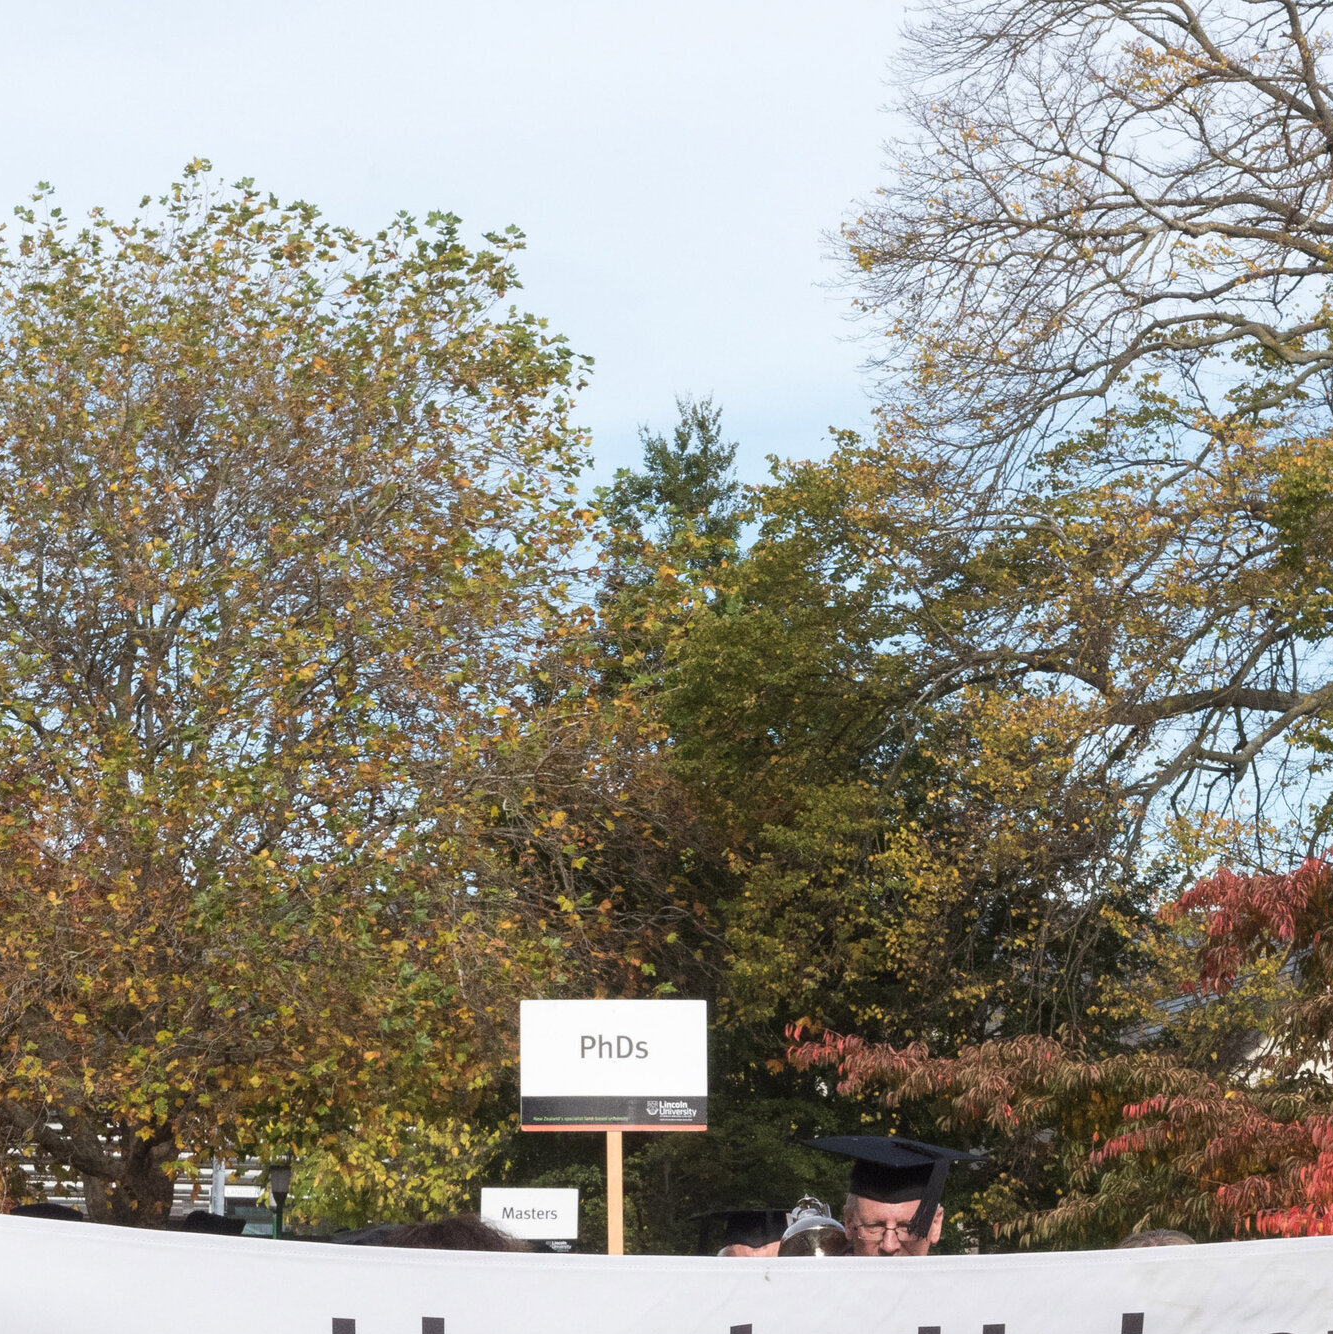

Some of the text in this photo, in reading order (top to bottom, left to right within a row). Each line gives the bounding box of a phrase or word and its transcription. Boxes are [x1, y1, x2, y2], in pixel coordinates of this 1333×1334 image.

[580, 1034, 649, 1059] PhDs
[659, 1100, 688, 1108] Lincoln
[659, 1107, 697, 1117] University
[501, 1206, 558, 1220] Masters
